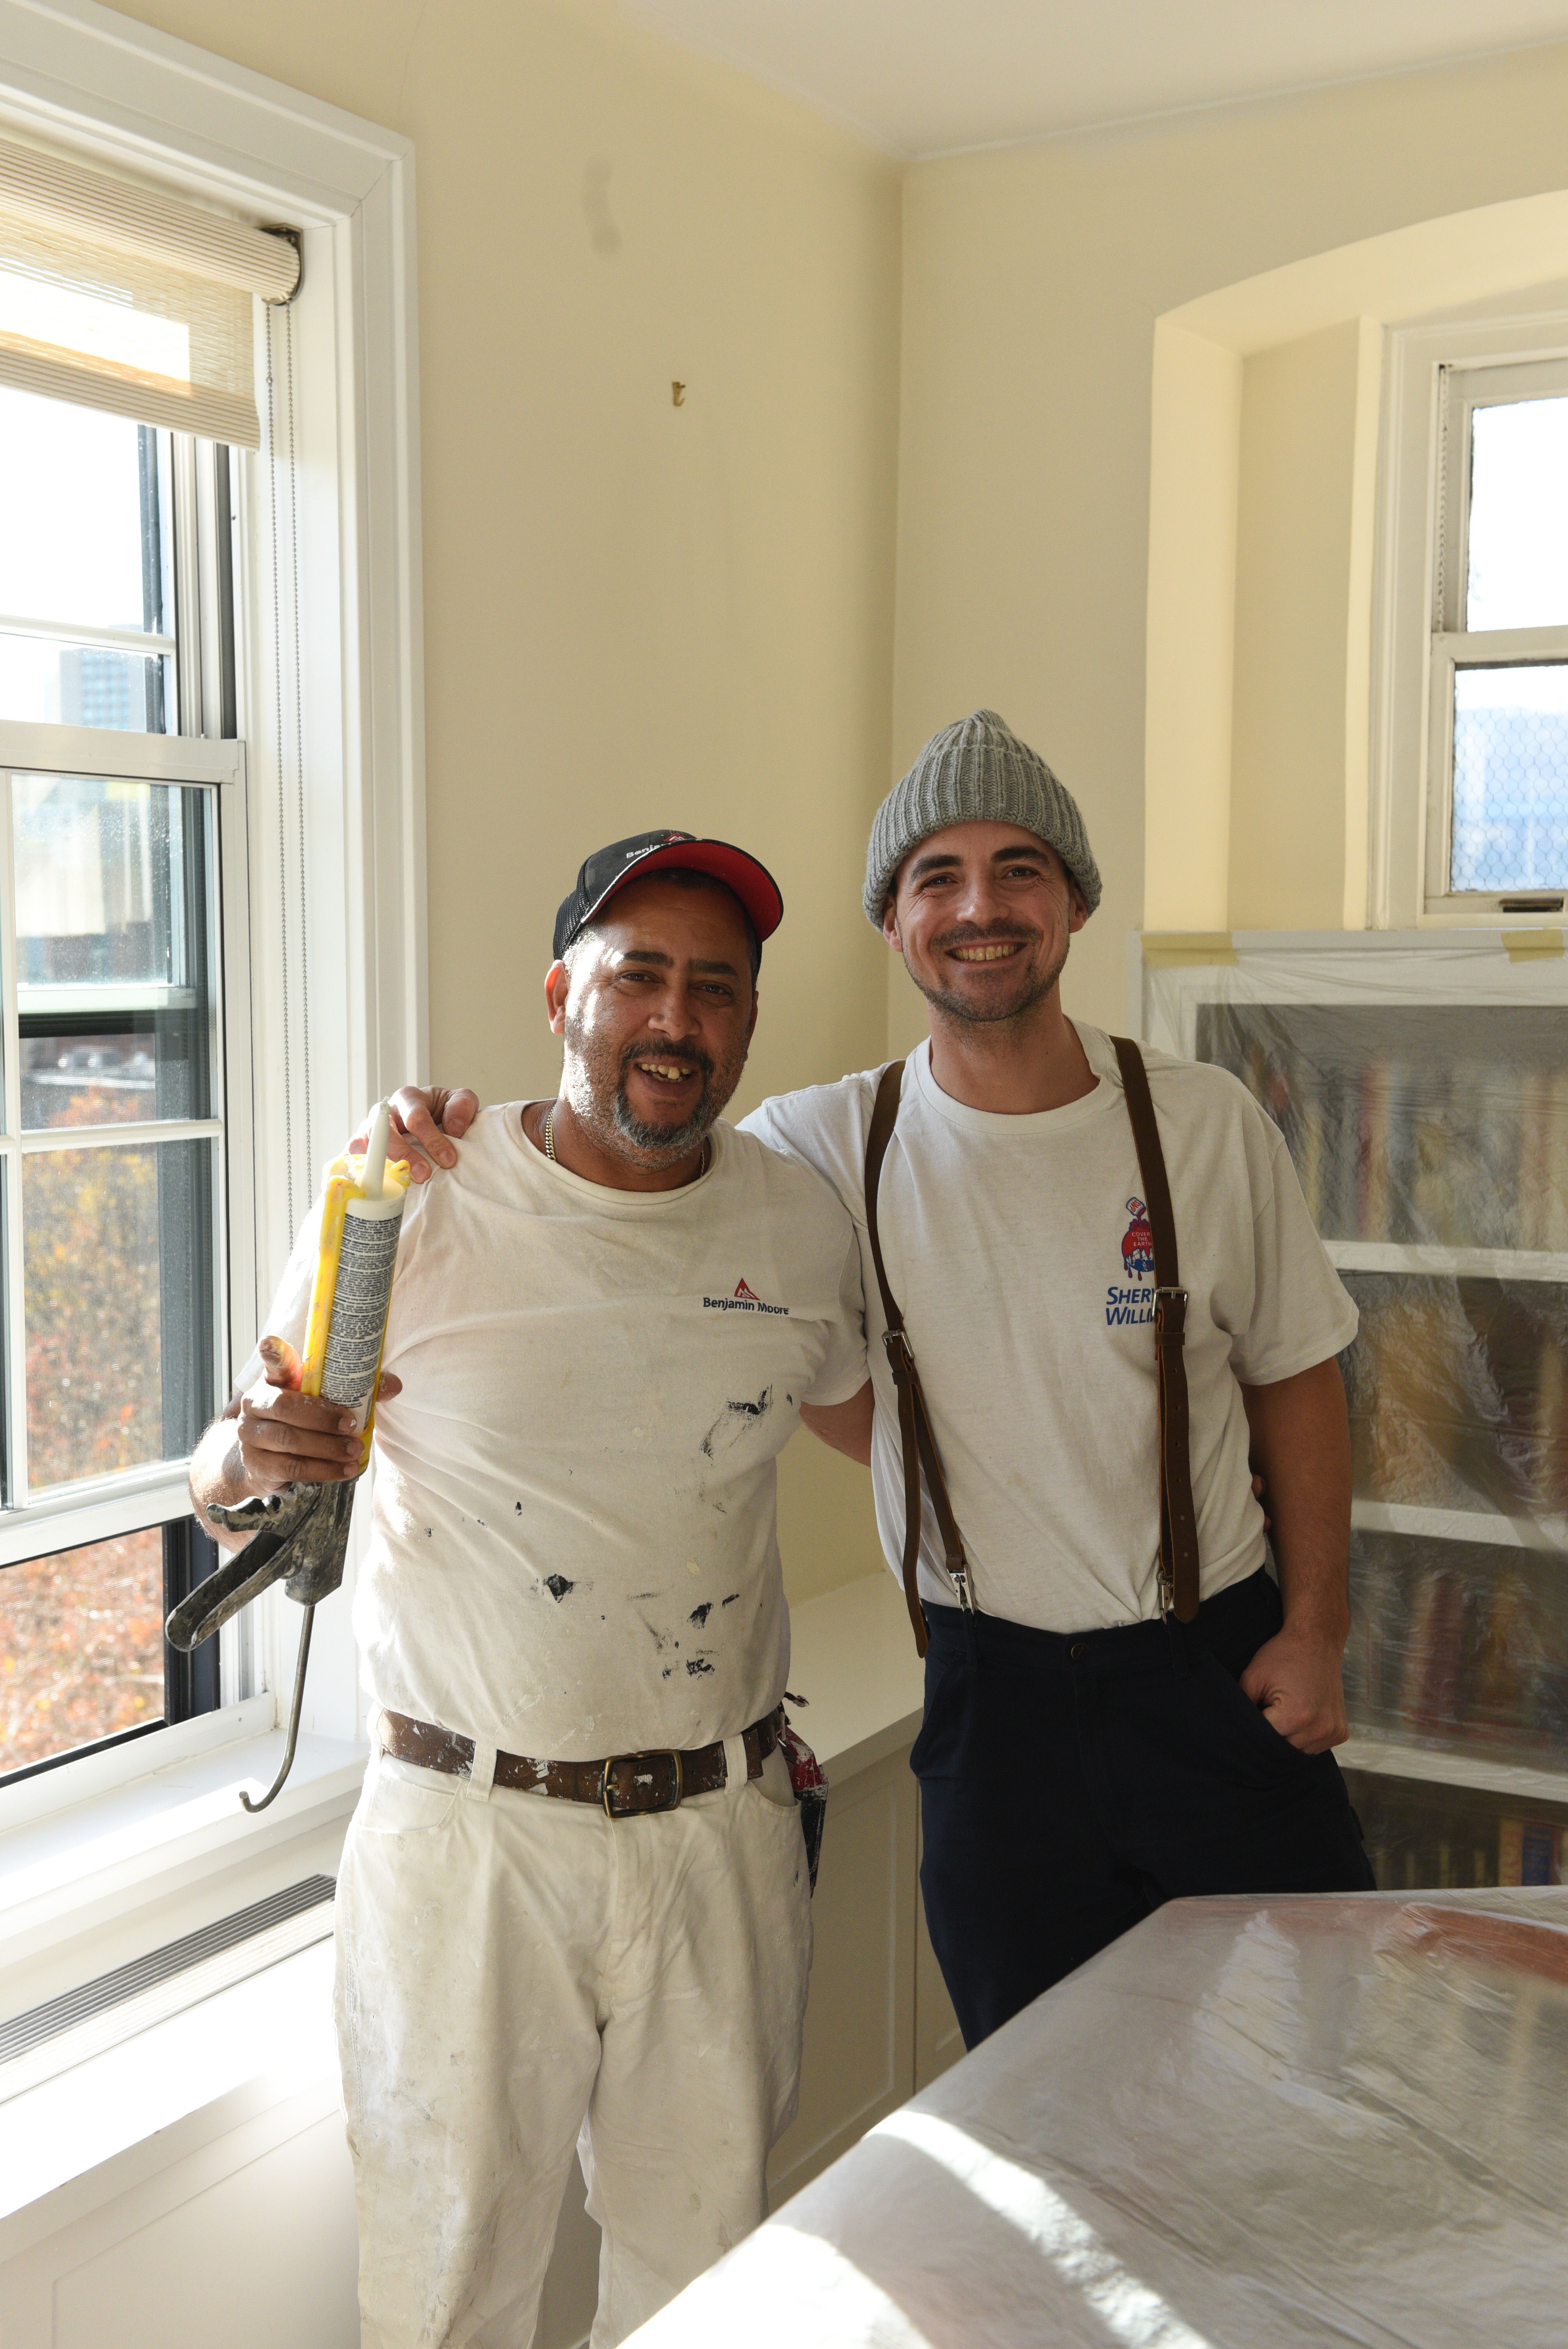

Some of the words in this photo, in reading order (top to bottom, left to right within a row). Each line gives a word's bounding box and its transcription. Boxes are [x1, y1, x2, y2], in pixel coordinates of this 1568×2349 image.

[626, 843, 671, 859] Benja
[1129, 1199, 1141, 1212] SWP
[703, 1297, 755, 1311] Benjamin
